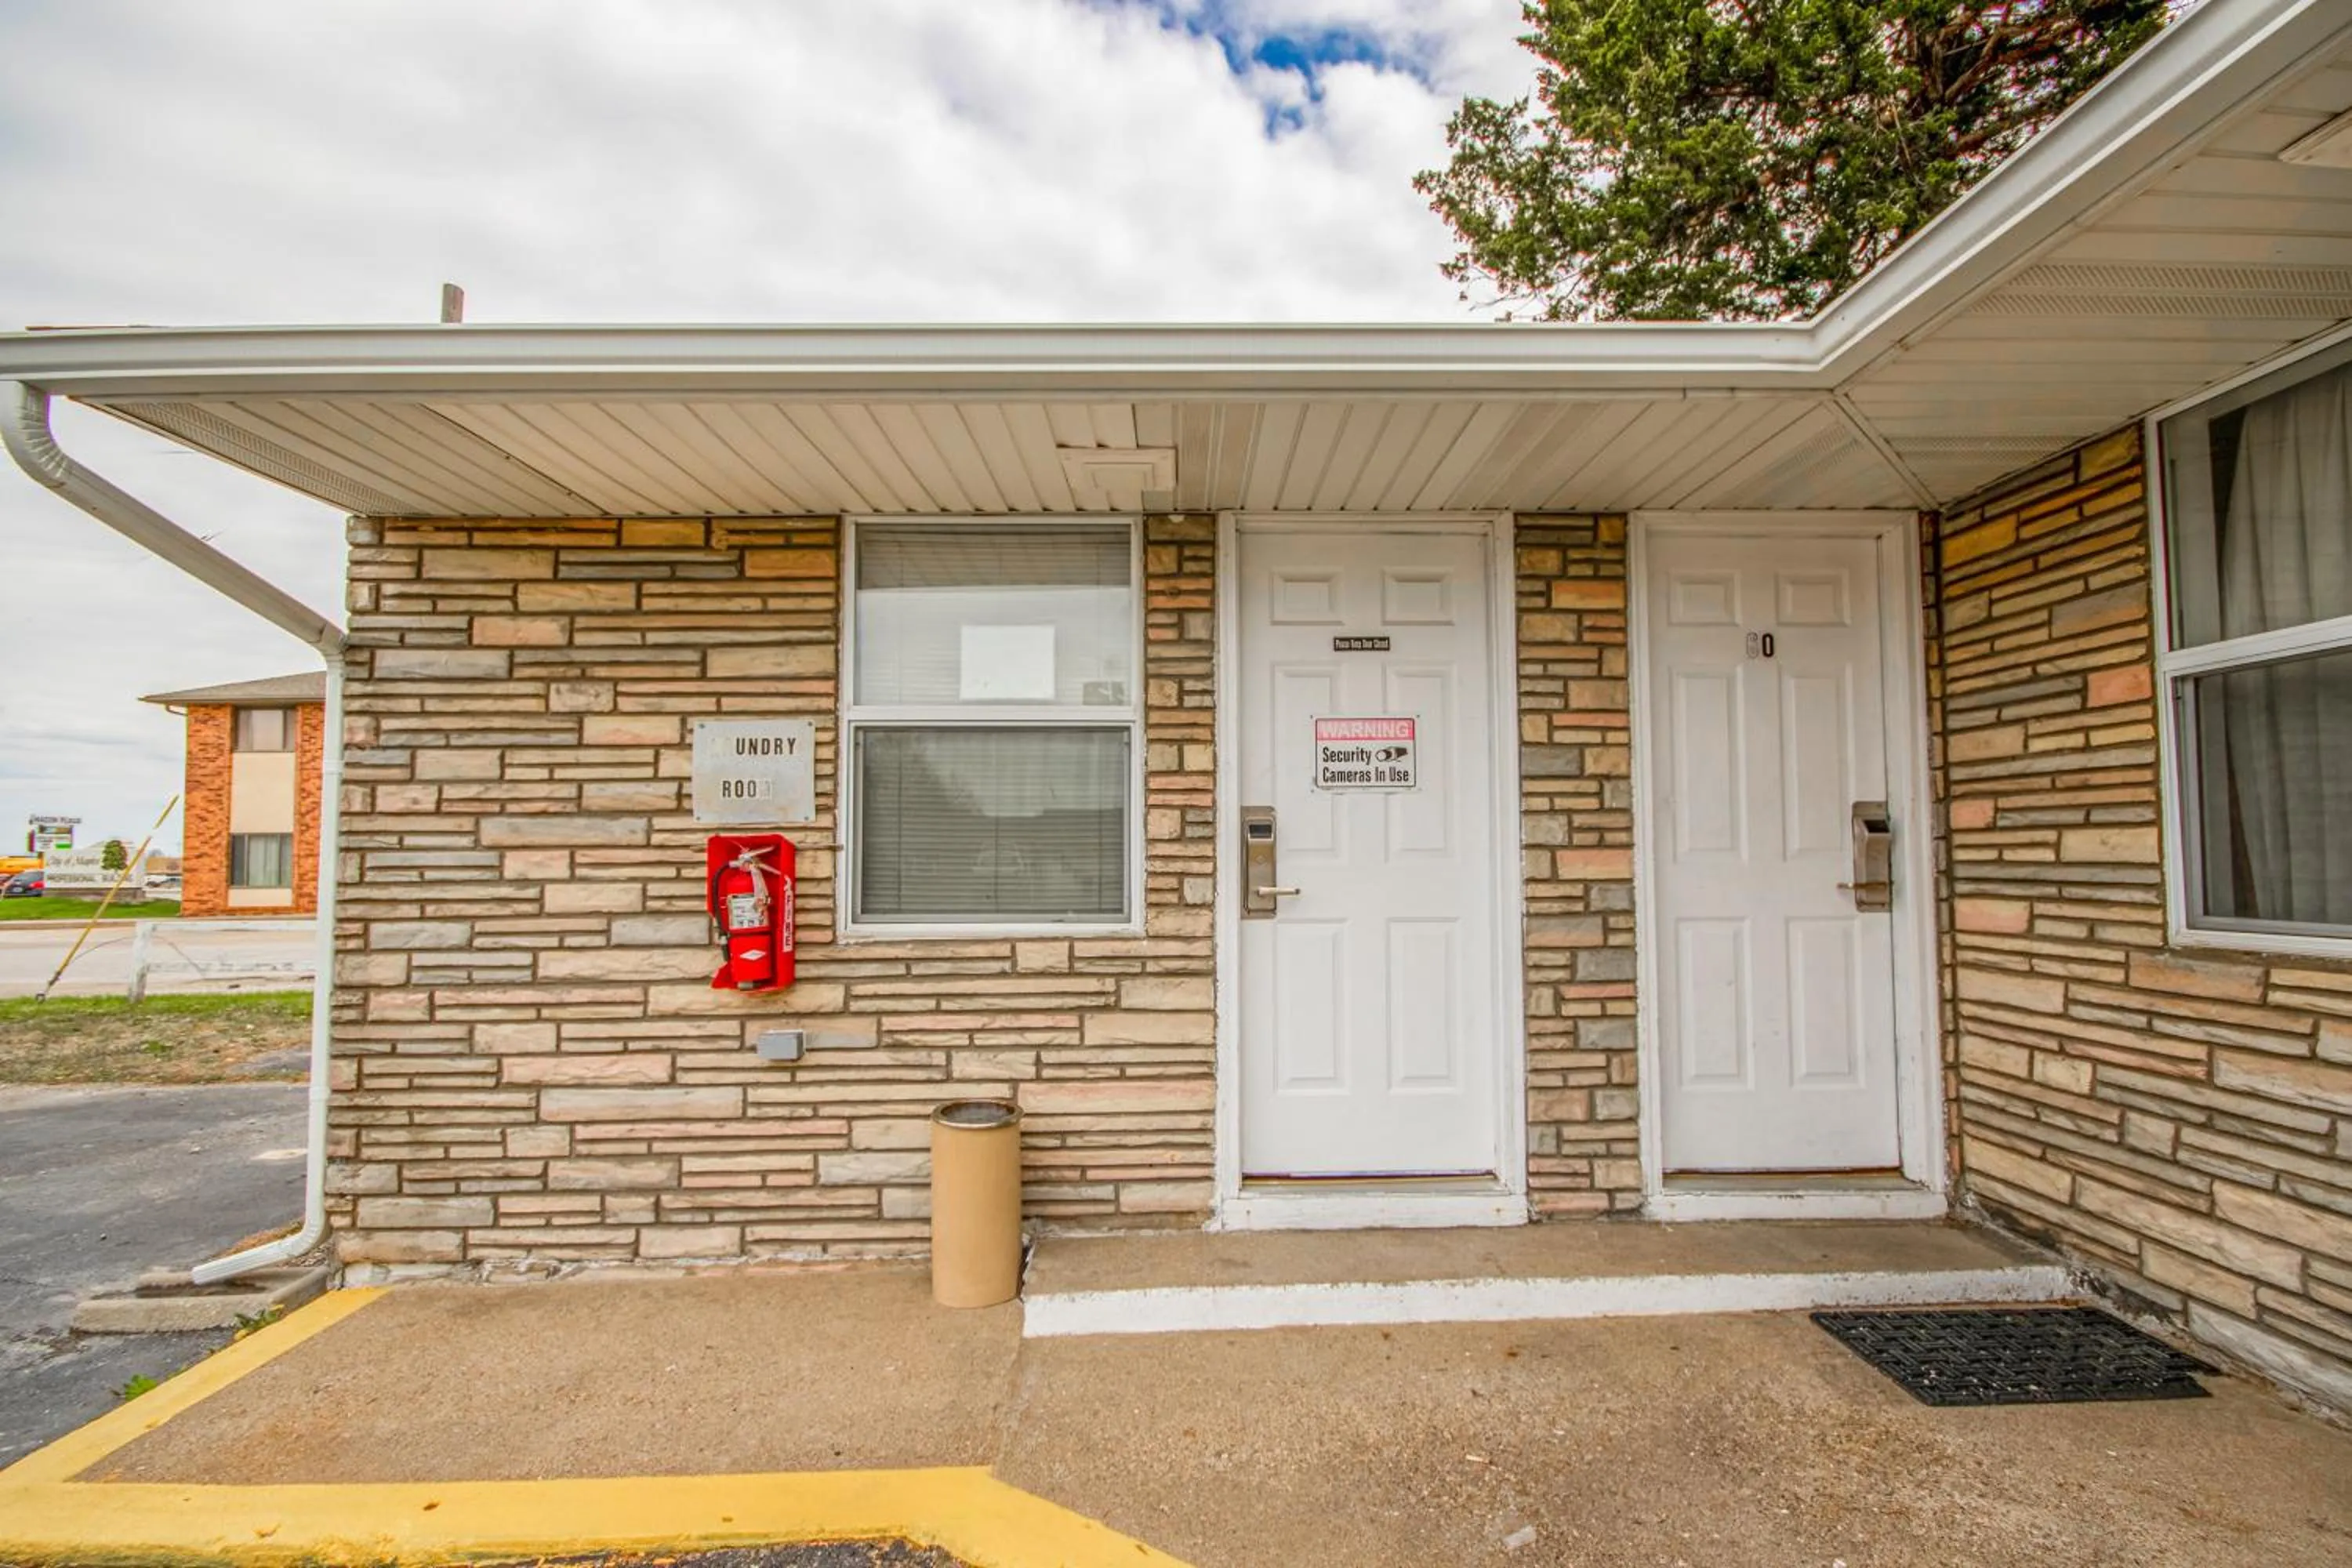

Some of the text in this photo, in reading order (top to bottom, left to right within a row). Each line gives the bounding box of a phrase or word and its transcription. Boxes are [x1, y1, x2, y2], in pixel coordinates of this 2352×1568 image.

[1320, 722, 1409, 738] WARNING
[711, 738, 797, 755] UNDRY
[1323, 746, 1371, 765] Security
[1323, 767, 1409, 782] Cameras In Use
